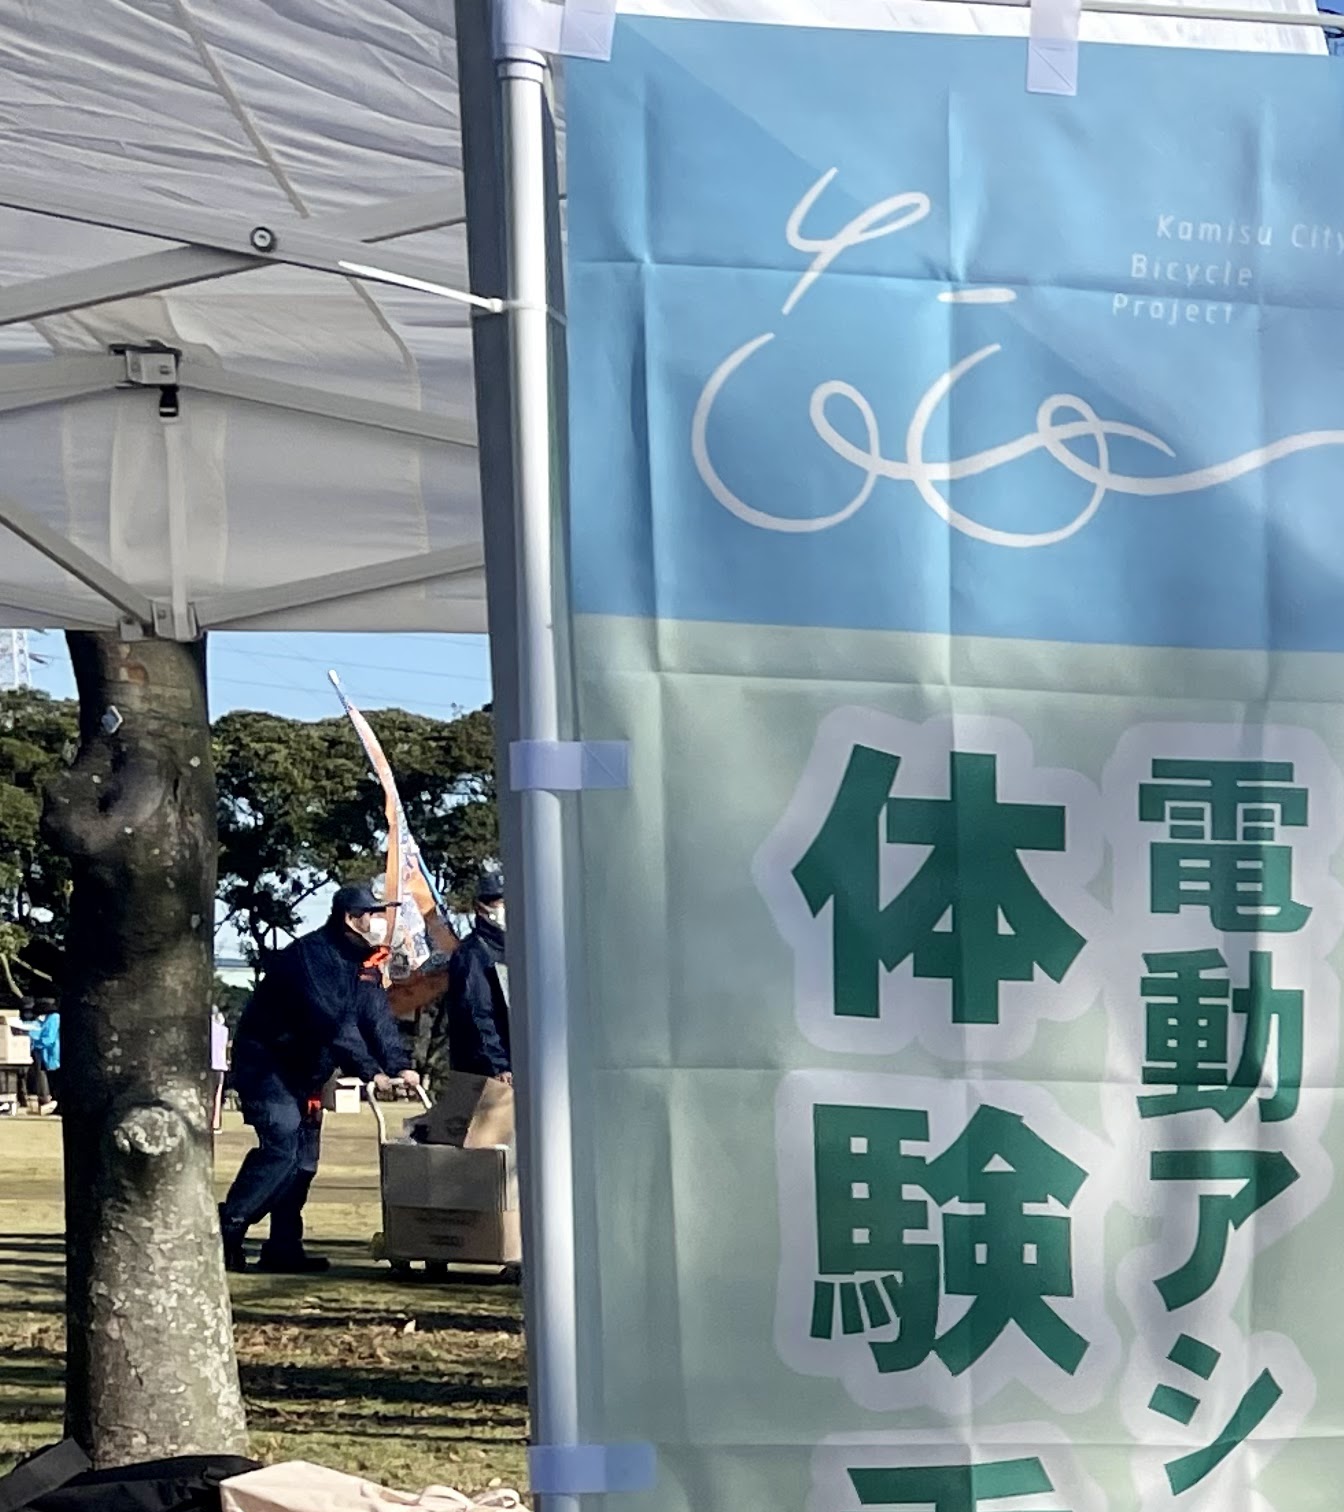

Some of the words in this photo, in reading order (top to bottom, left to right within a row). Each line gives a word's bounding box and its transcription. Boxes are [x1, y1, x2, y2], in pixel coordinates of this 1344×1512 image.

[1156, 213, 1273, 247] Kamisu
[1130, 252, 1254, 288] Bicycle
[1111, 291, 1234, 327] Project
